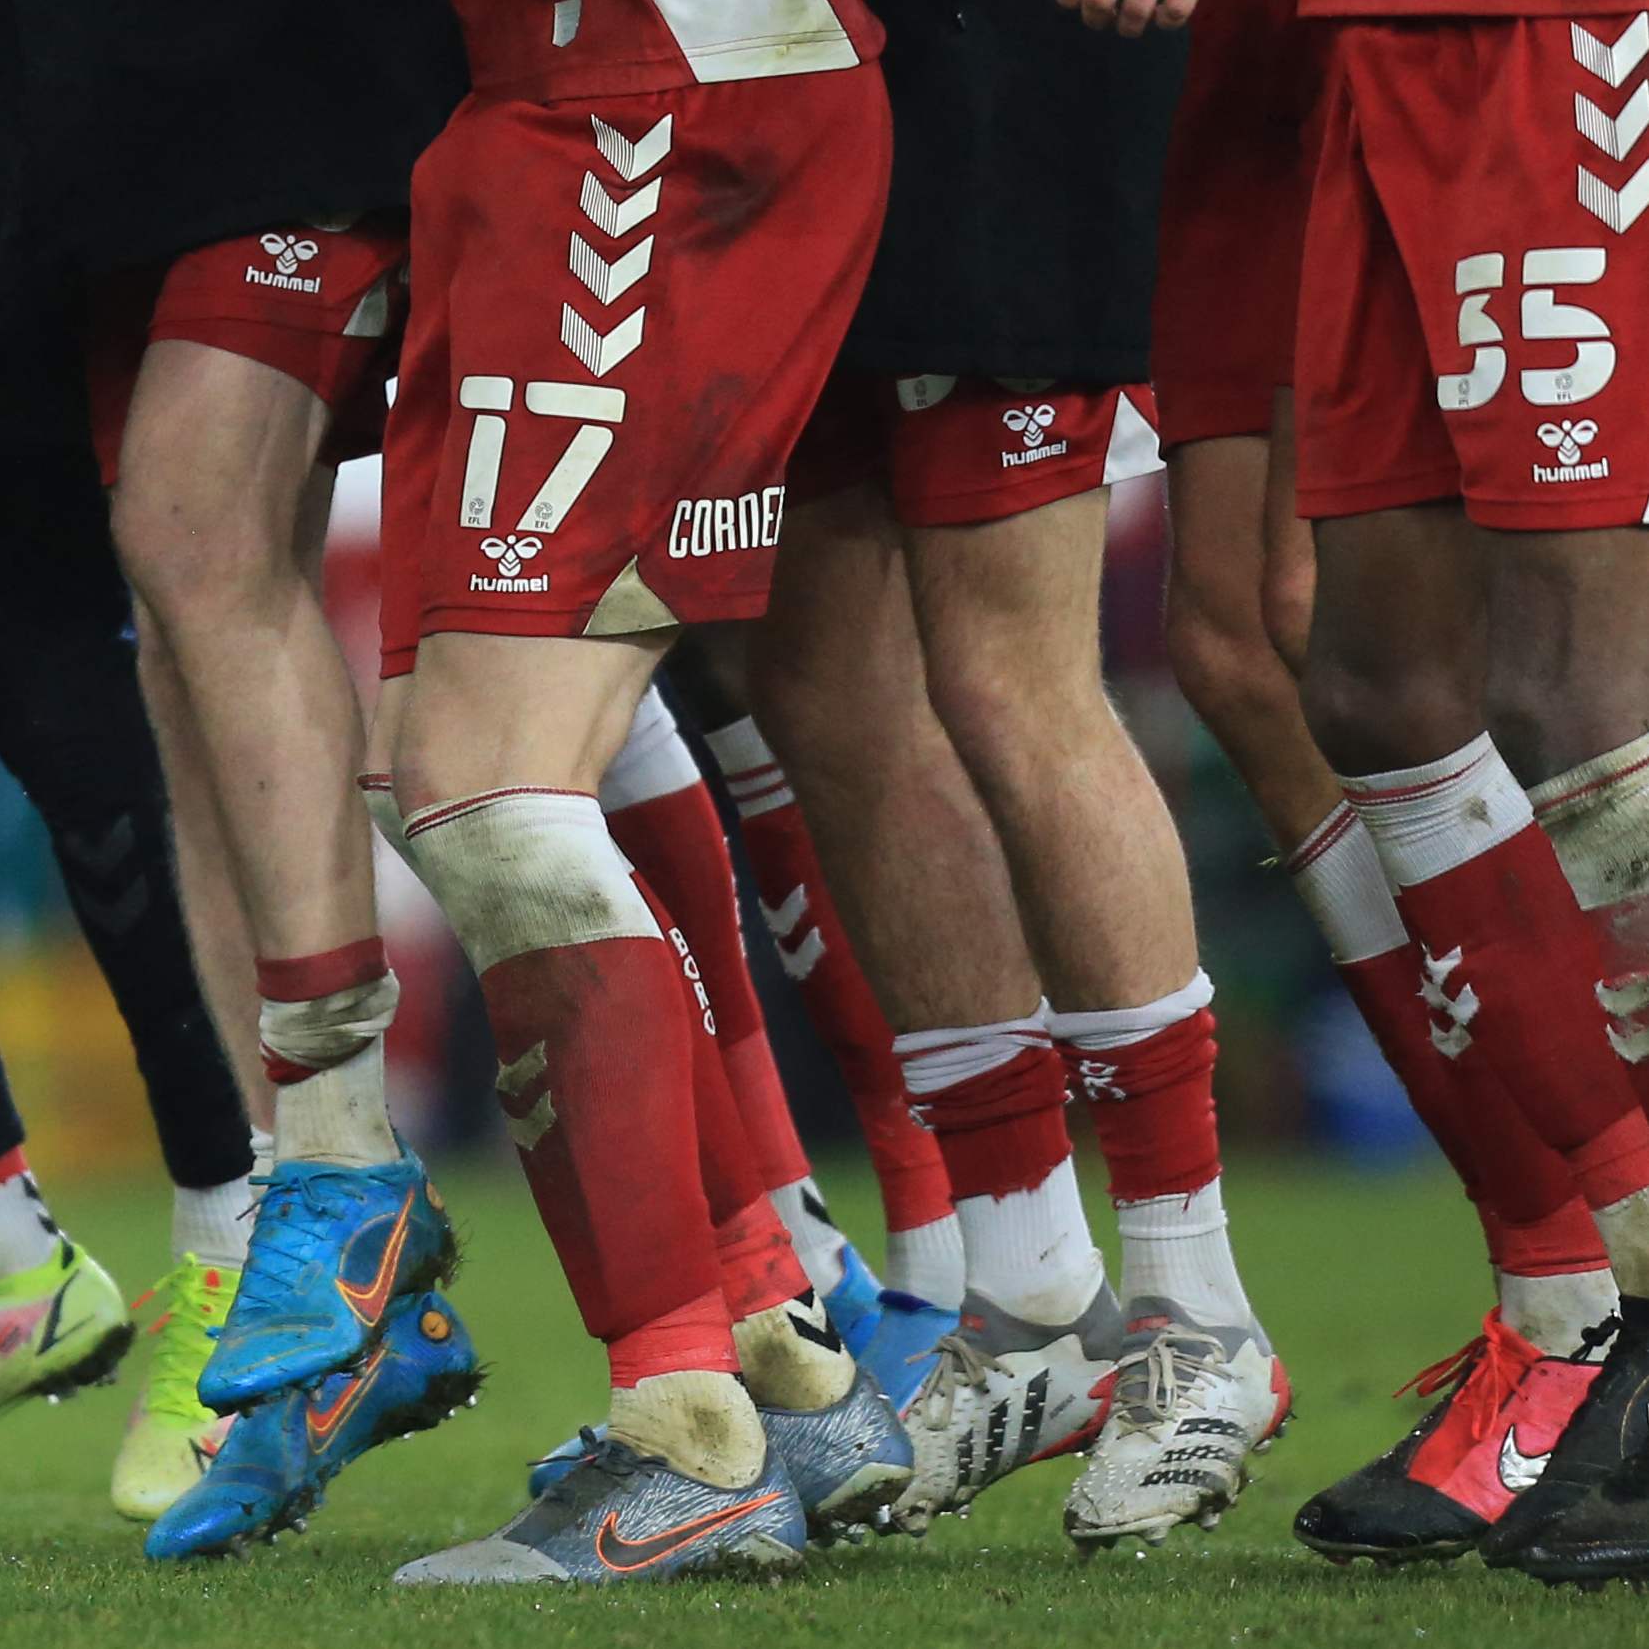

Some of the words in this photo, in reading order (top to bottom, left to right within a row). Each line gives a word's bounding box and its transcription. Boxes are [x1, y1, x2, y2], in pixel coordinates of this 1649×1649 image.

[245, 265, 321, 294] hummel
[459, 375, 626, 534] 17
[1001, 439, 1067, 468] hummel
[1532, 456, 1609, 483] hummel
[534, 520, 550, 529] EFL
[469, 573, 549, 592] hummel
[668, 926, 717, 1036] BORO
